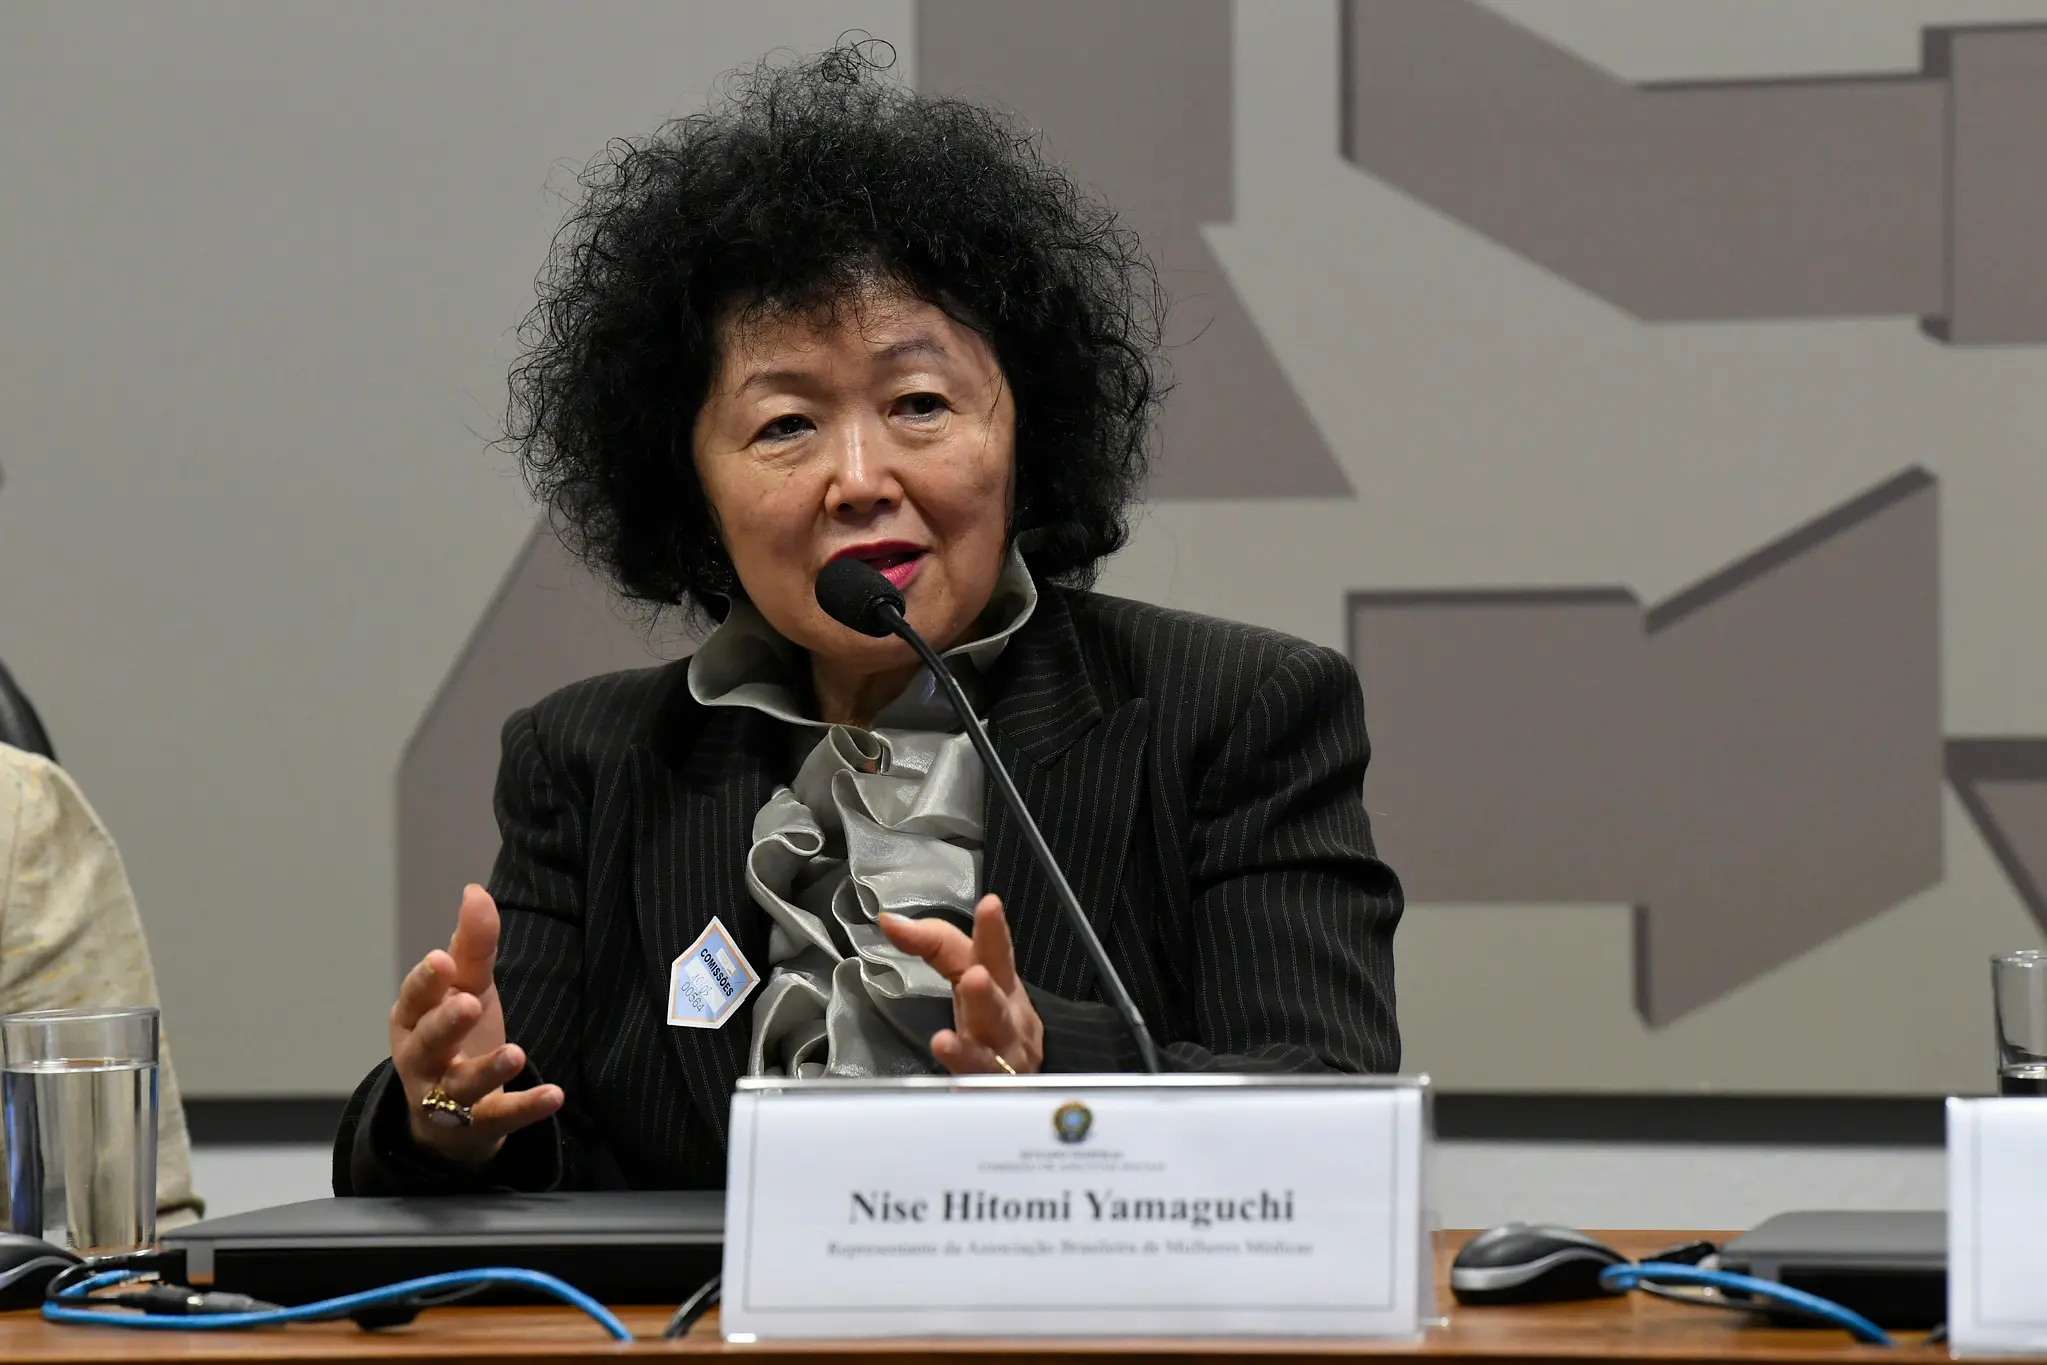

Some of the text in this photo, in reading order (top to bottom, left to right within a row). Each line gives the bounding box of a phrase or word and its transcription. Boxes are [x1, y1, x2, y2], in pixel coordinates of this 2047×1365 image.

[700, 948, 734, 997] COMISSÕES
[681, 981, 705, 1013] 00564
[849, 1190, 1294, 1229] Nise Hitomi Yamaguchi
